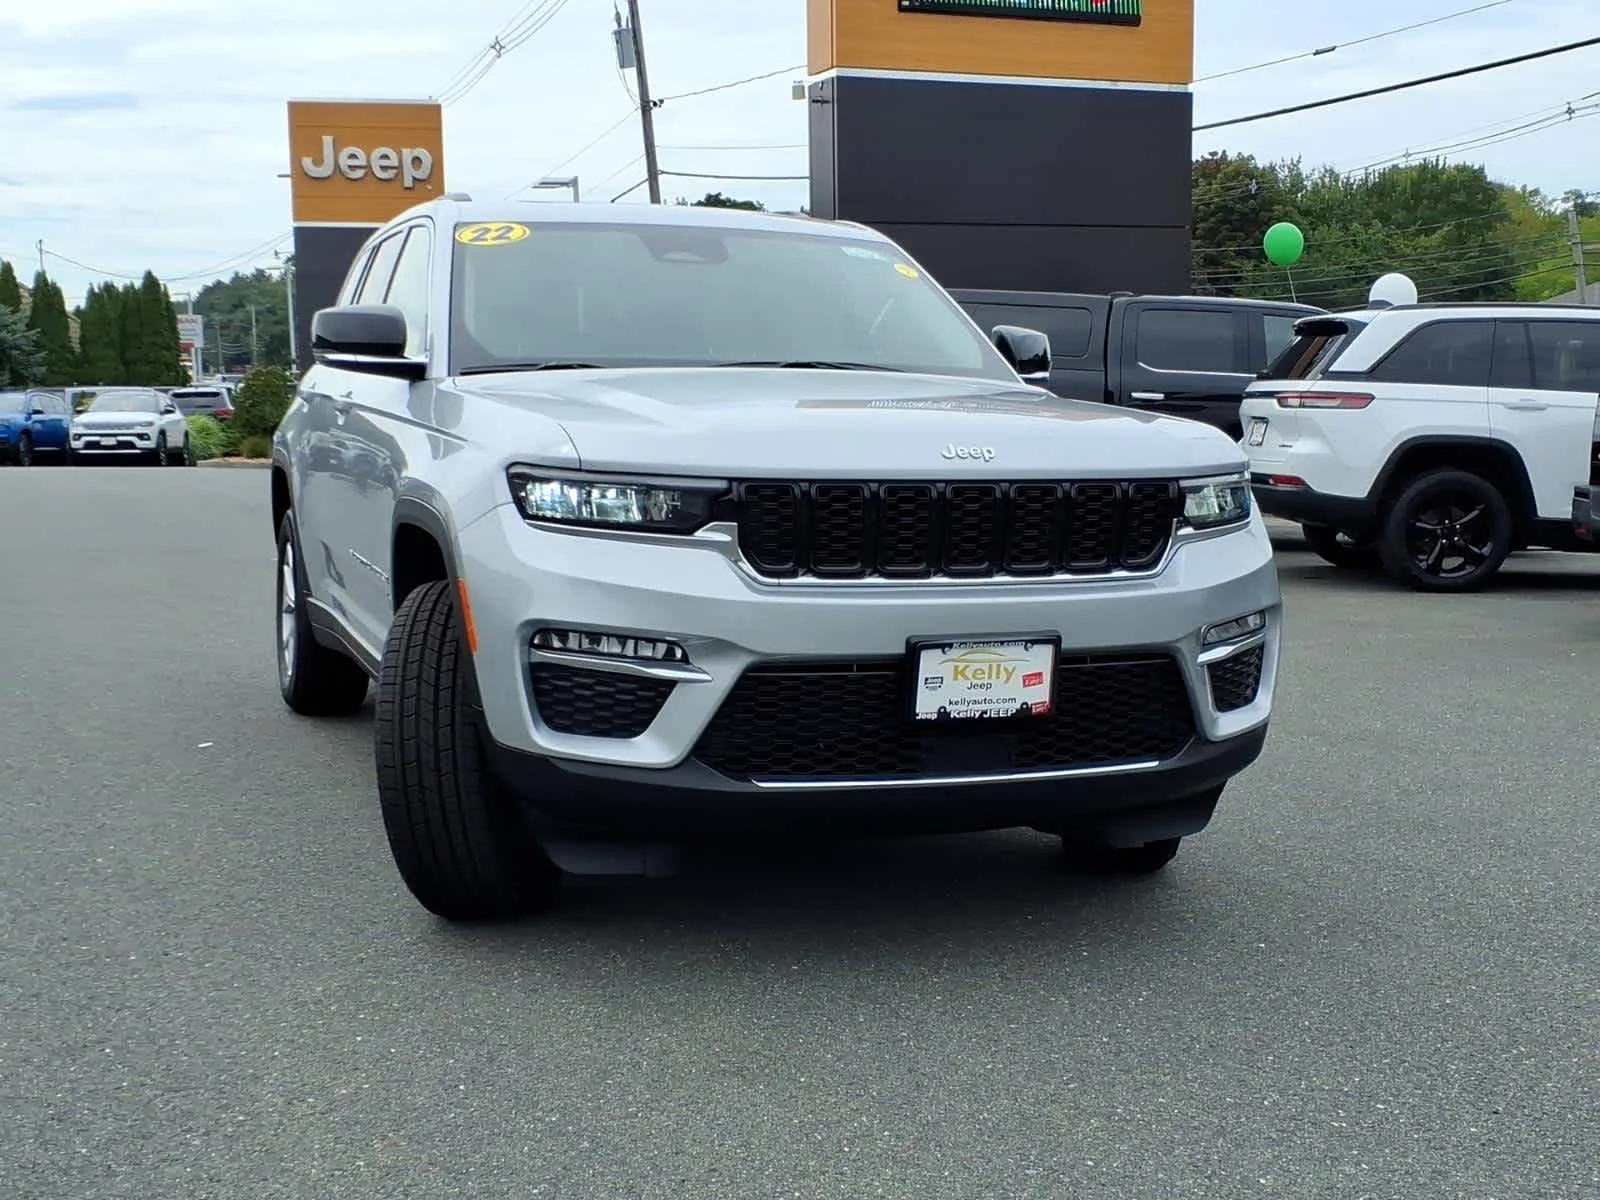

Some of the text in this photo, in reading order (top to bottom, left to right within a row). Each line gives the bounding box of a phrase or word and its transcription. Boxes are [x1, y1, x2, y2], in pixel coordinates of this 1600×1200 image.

[301, 135, 432, 188] Jeep
[467, 225, 513, 242] 22
[941, 443, 995, 462] Jeep
[953, 664, 1016, 684] Kelly
[967, 681, 993, 691] Jeep
[948, 697, 1017, 707] kellyauto.com
[916, 712, 937, 720] Jeep
[950, 708, 1017, 719] Kelly JEEP
